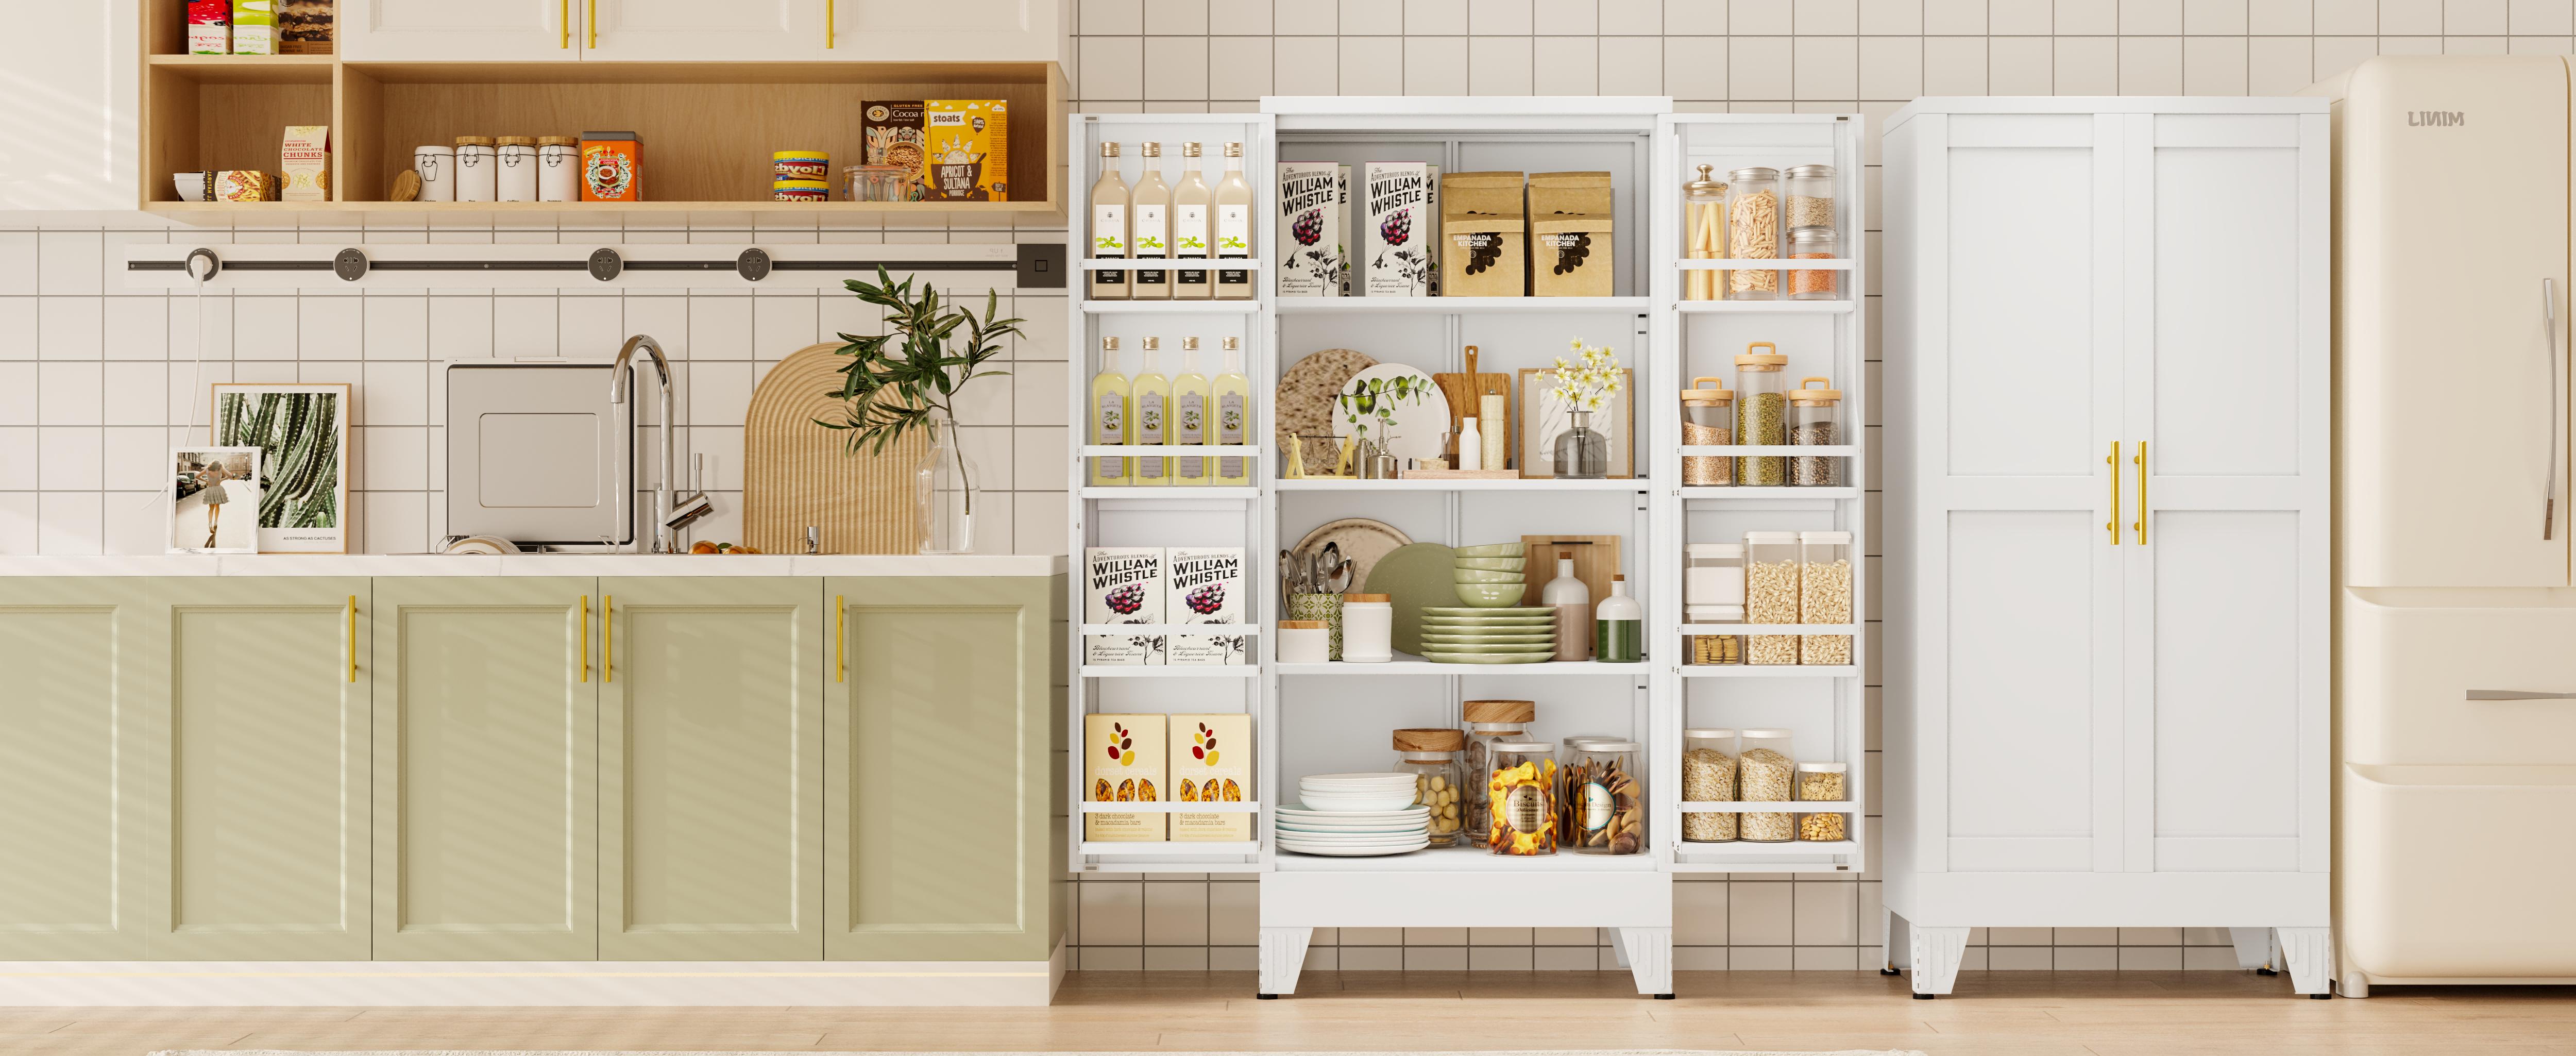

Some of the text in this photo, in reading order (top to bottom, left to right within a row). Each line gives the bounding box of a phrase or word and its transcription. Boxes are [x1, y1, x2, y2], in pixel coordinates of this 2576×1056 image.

[941, 165, 972, 178] APRICOT &
[1283, 172, 1311, 181] ADVENTUROUS
[1370, 172, 1399, 181] ADVENTUROUS
[944, 177, 970, 190] SULTANA
[1283, 177, 1333, 198] WILLIAM
[1370, 177, 1421, 198] WILLIAM
[1283, 190, 1333, 216] WHISTLE
[1371, 190, 1421, 216] WHISTLE
[1093, 559, 1157, 576] WILLIAM
[1173, 559, 1238, 576] WILLIAM
[1093, 569, 1157, 590] WHISTLE
[1173, 569, 1238, 590] WHISTLE
[1095, 766, 1157, 775] dorset cereals
[1179, 766, 1241, 775] dorset cereals
